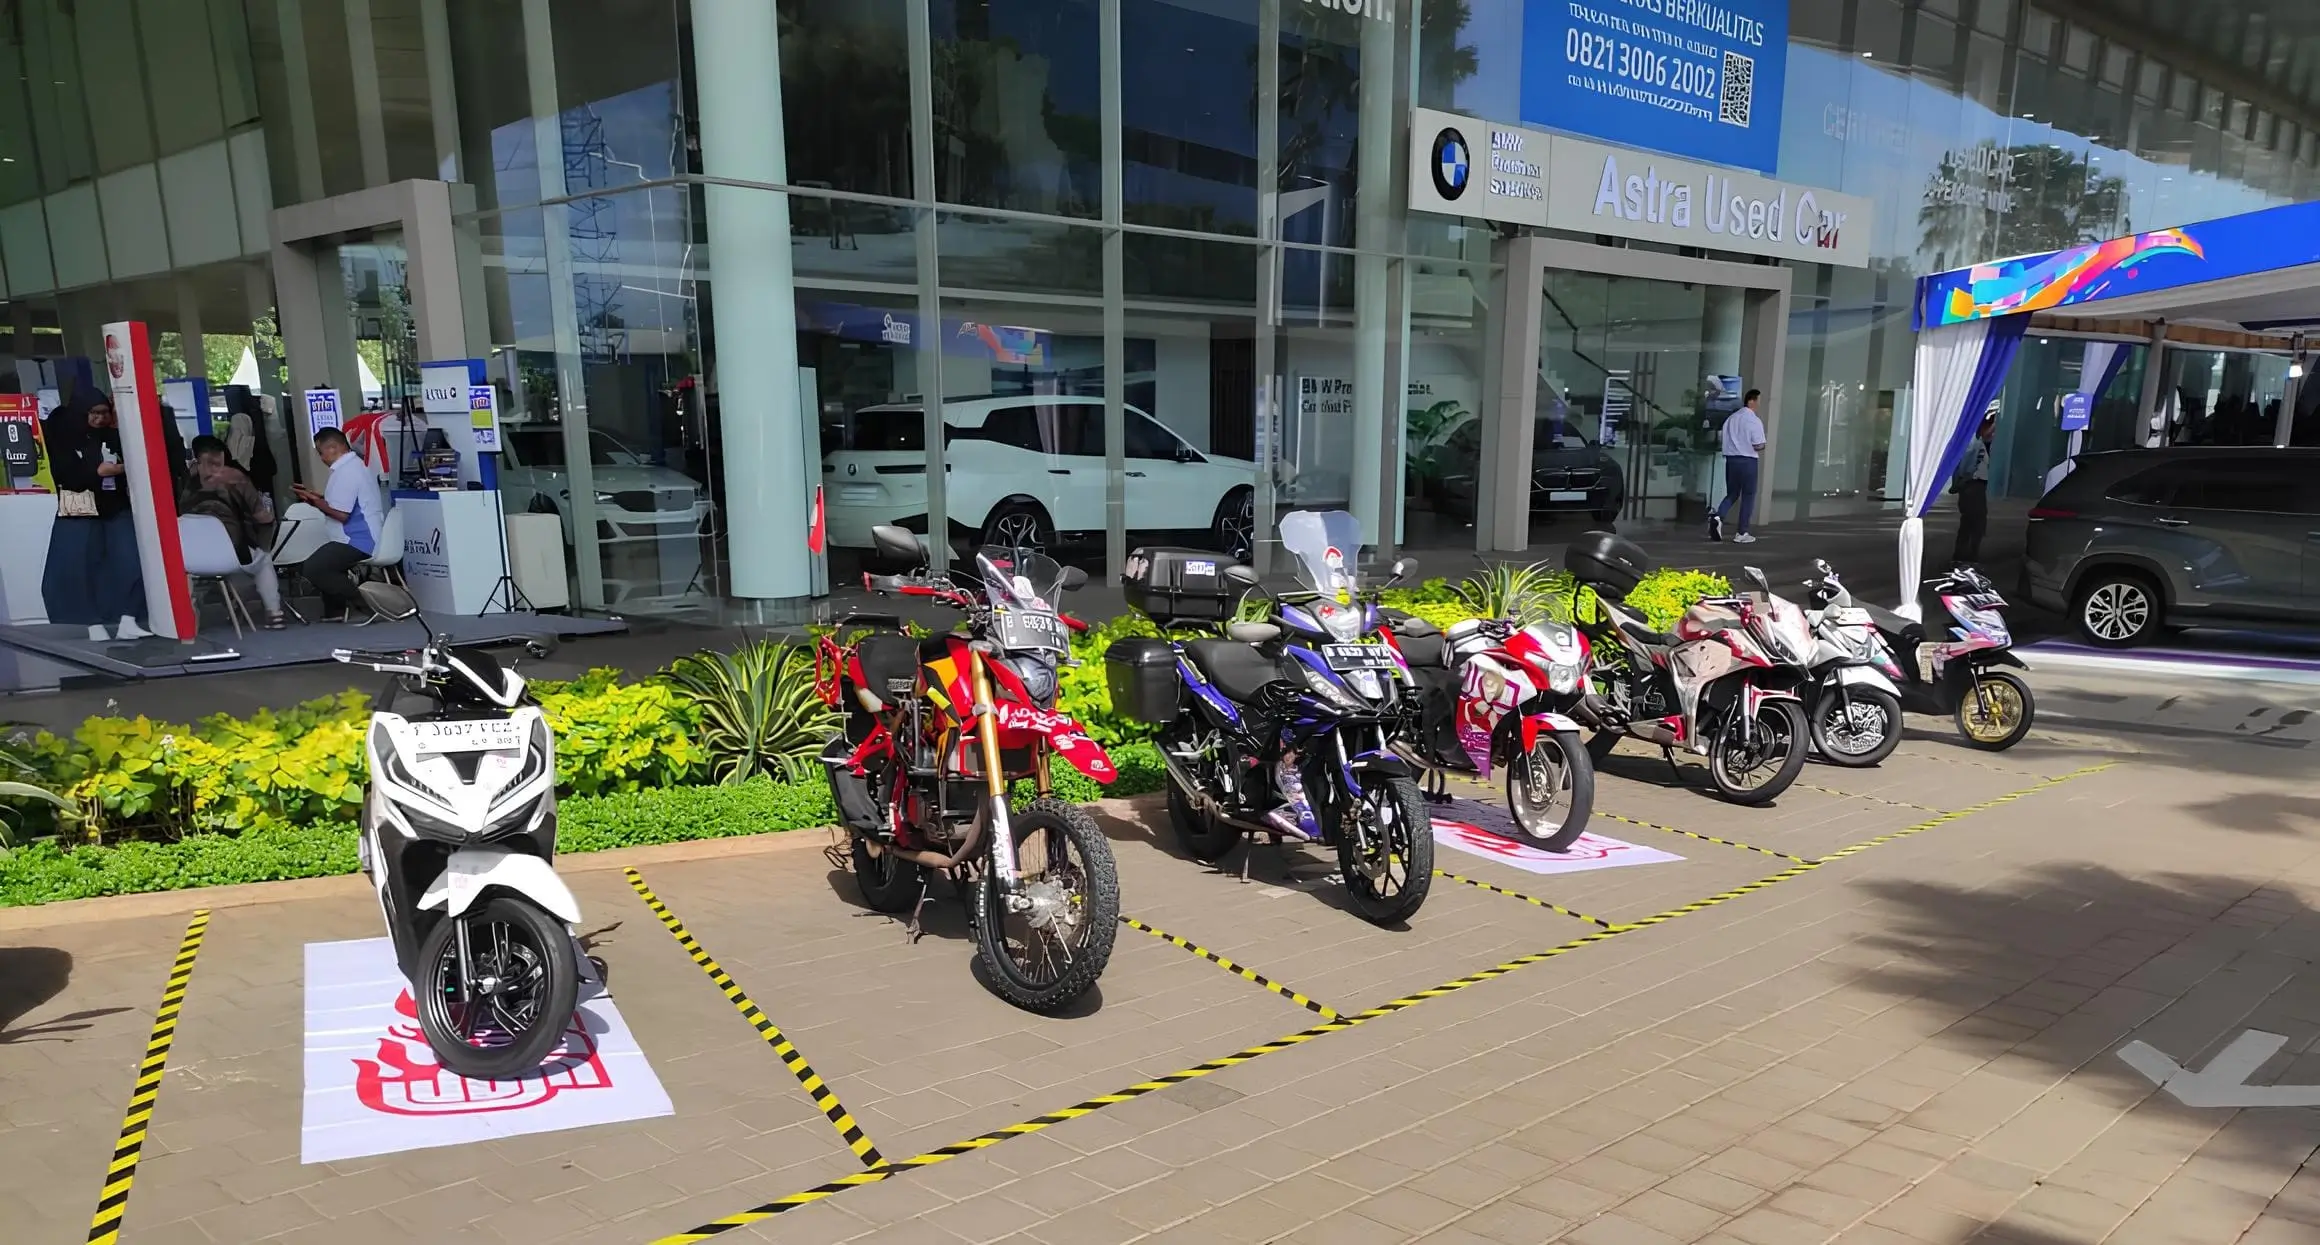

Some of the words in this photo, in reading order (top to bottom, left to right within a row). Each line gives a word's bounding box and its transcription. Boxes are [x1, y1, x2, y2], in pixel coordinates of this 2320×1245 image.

[1665, 0, 1764, 46] BERKUALITAS
[1566, 28, 1613, 73] 0821
[1618, 42, 1667, 86] 3006
[1671, 58, 1715, 99] 2002
[1592, 154, 1691, 228] Astra
[1704, 173, 1786, 242] Used
[1795, 190, 1847, 249] Car
